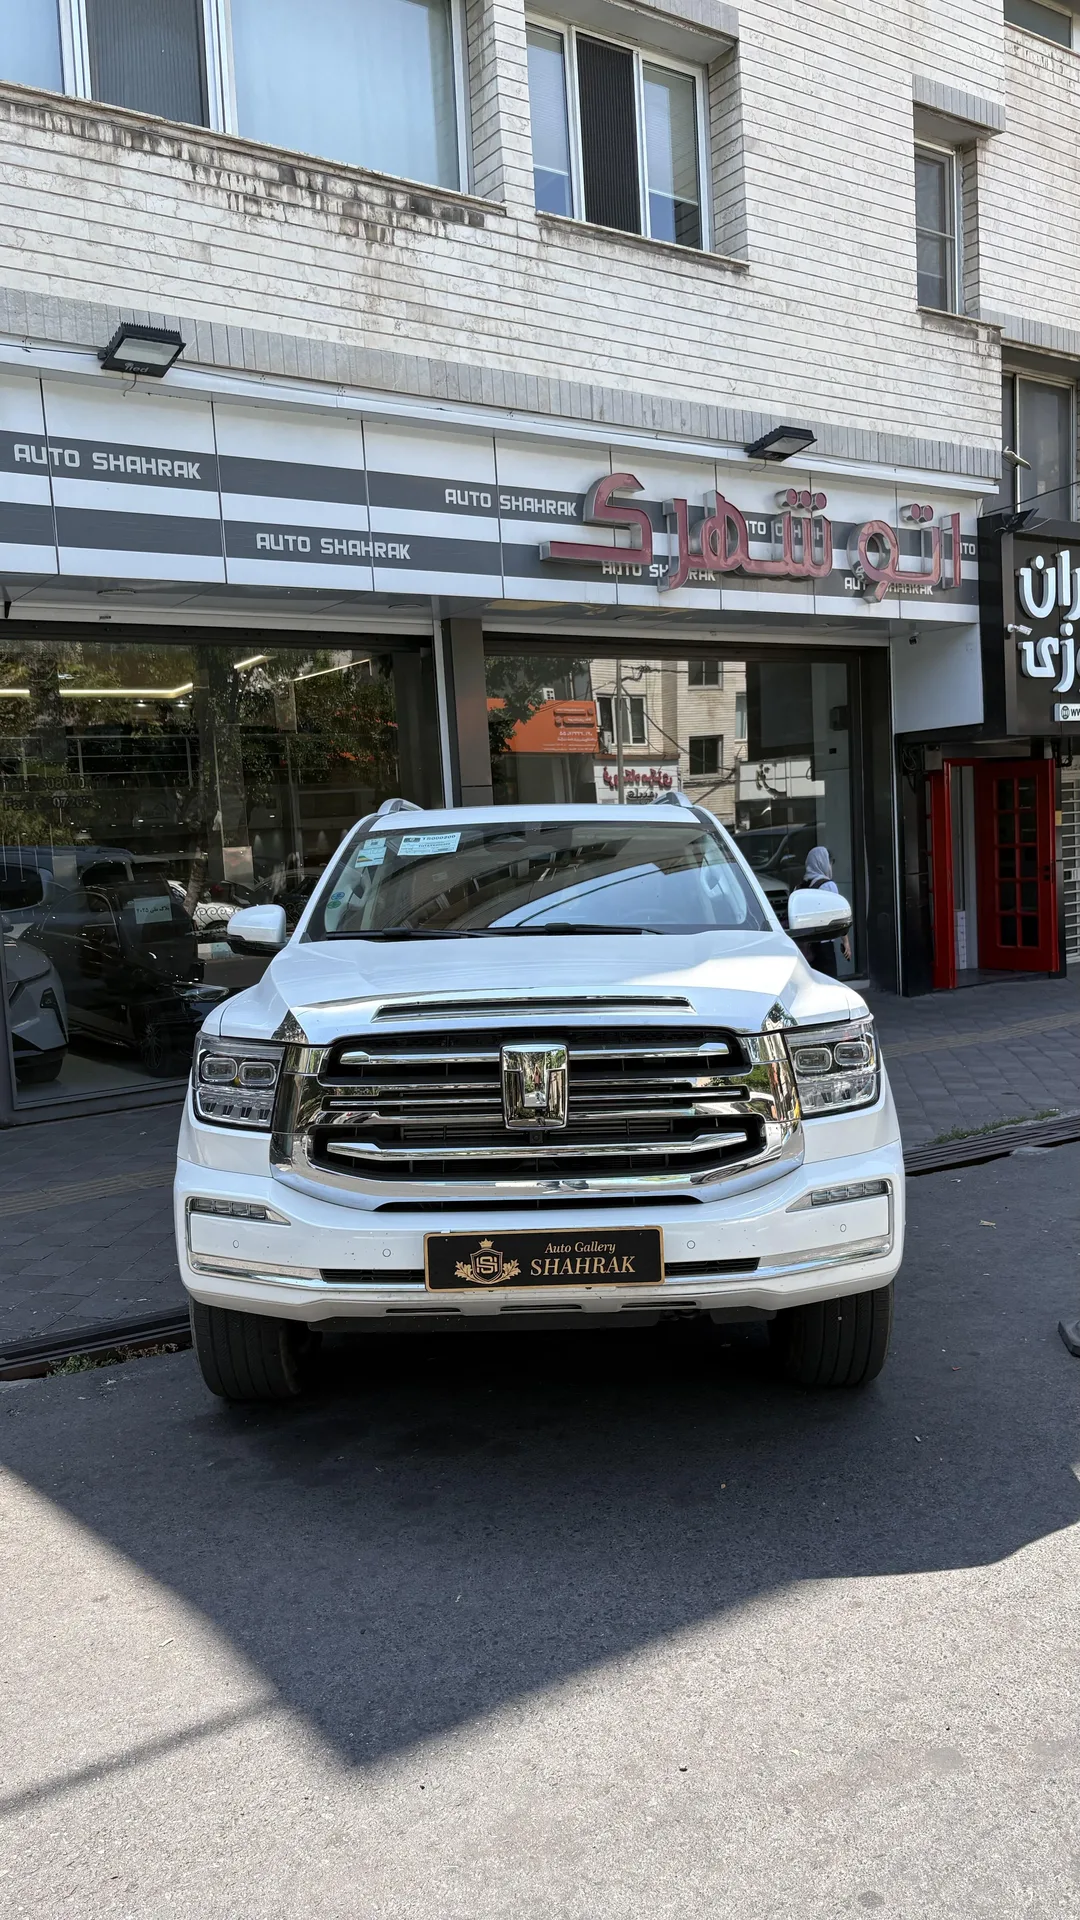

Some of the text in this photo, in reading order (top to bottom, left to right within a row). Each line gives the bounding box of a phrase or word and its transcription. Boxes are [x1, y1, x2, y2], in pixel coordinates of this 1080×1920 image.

[13, 443, 202, 480] AUTO SHAHRAK
[445, 488, 577, 517] AUTO SHAHRAK
[256, 533, 411, 560] AUTO SHAHRAK
[541, 472, 962, 604] اتو شهرک
[649, 563, 716, 582] SHRAK
[545, 1241, 616, 1255] Auto Gallery
[530, 1255, 636, 1276] SHAHRAK
